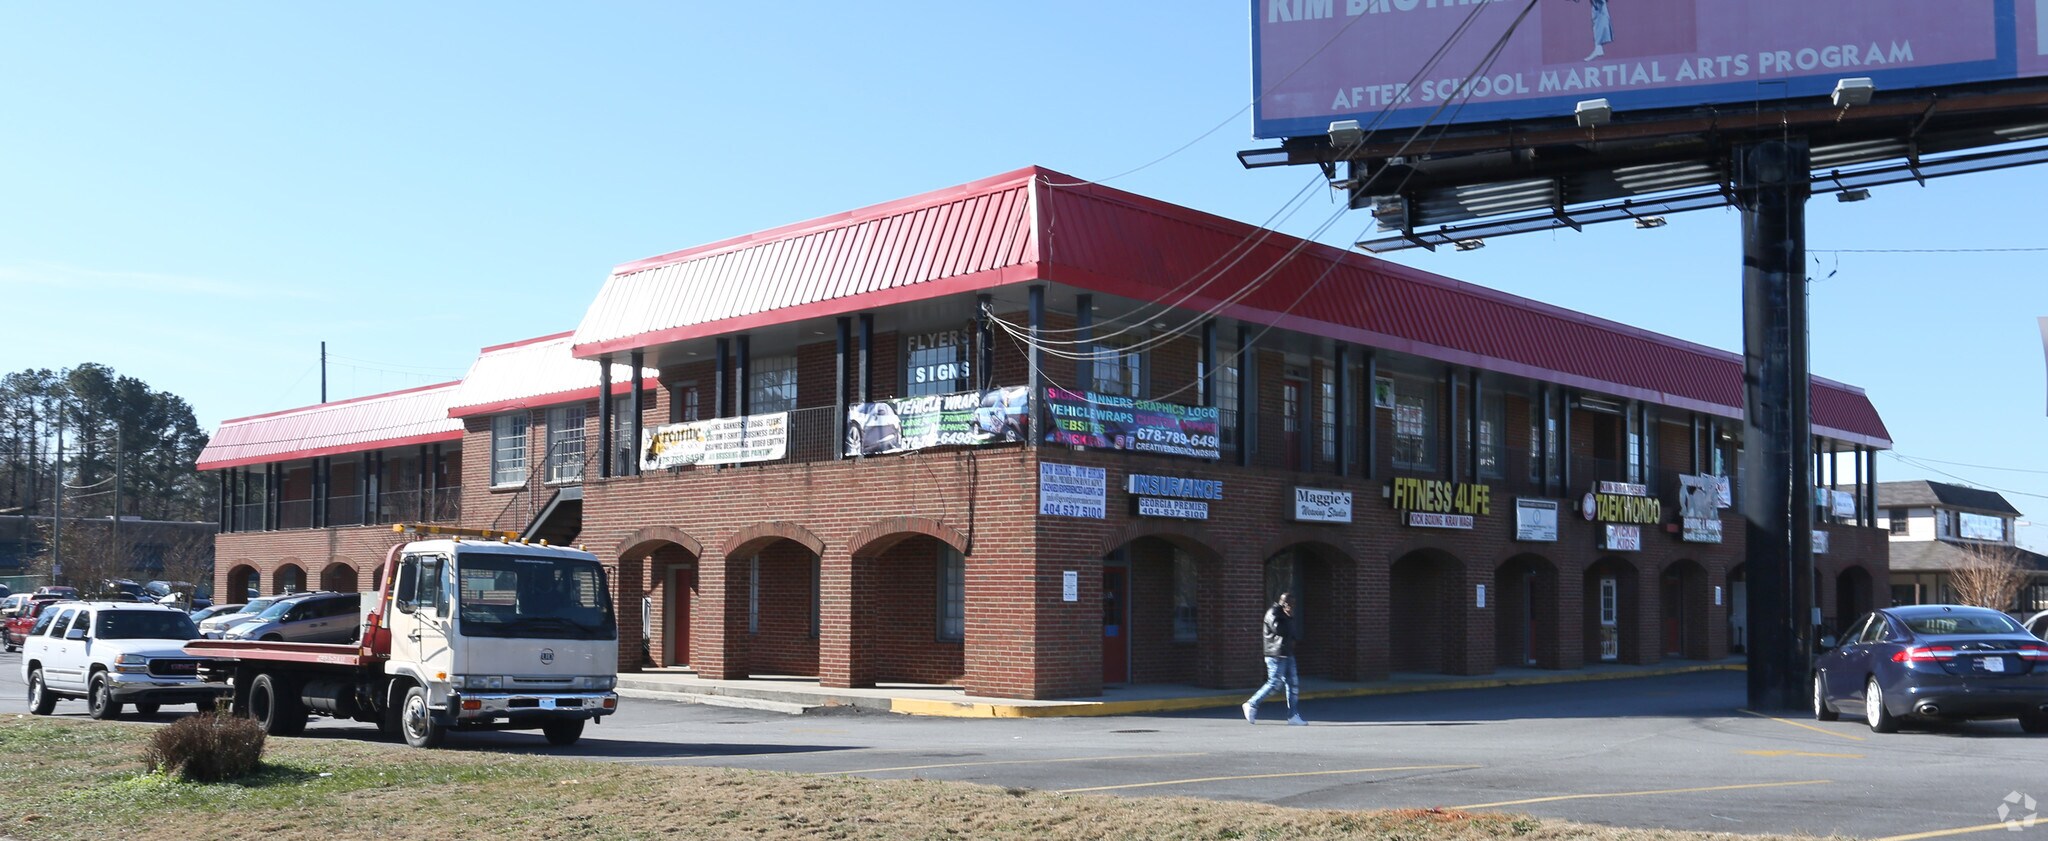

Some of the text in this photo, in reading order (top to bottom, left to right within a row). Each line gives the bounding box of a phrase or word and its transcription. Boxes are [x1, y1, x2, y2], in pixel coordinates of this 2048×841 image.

[1331, 40, 1914, 110] AFTER SCHOOL MARTIAL ARTS PROGRAM
[907, 329, 969, 351] FLYERS
[916, 361, 970, 383] SIGNS
[896, 393, 979, 415] VEHICLE WRAPS
[1048, 387, 1084, 401] SIGNS
[1087, 392, 1134, 409] BANNERS
[1136, 400, 1185, 415] GRAPHICS
[1055, 419, 1106, 435] WEBSITES
[1133, 474, 1223, 500] INSURANCE
[1298, 489, 1351, 507] Maggie's
[1394, 478, 1489, 515] FITNESS 4LIFE
[1043, 503, 1102, 518] 404.537.5100
[1140, 499, 1207, 511] GEORGIA PREMIER
[1142, 508, 1205, 519] 404-537-5100
[1596, 494, 1660, 524] TAEKWONDO
